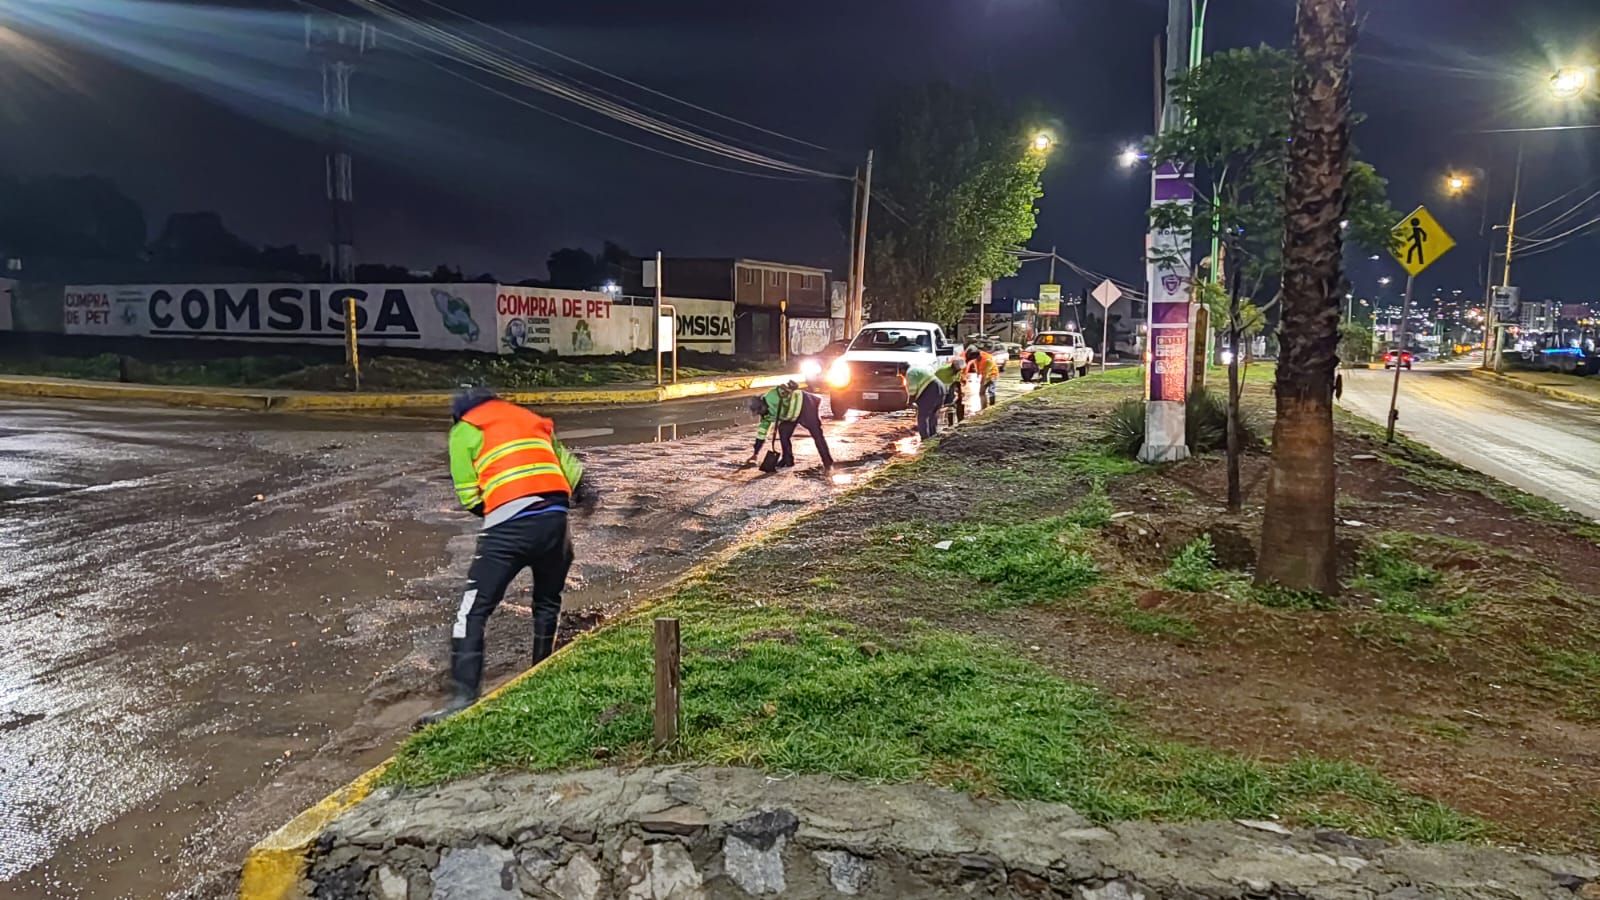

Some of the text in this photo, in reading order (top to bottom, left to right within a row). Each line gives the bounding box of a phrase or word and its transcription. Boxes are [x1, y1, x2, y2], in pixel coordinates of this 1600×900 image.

[66, 293, 110, 308] COMPRA
[148, 288, 419, 333] COMSISA
[497, 294, 612, 319] COMPRA DE PET
[66, 310, 111, 325] DE PET
[676, 315, 731, 336] OMSISA
